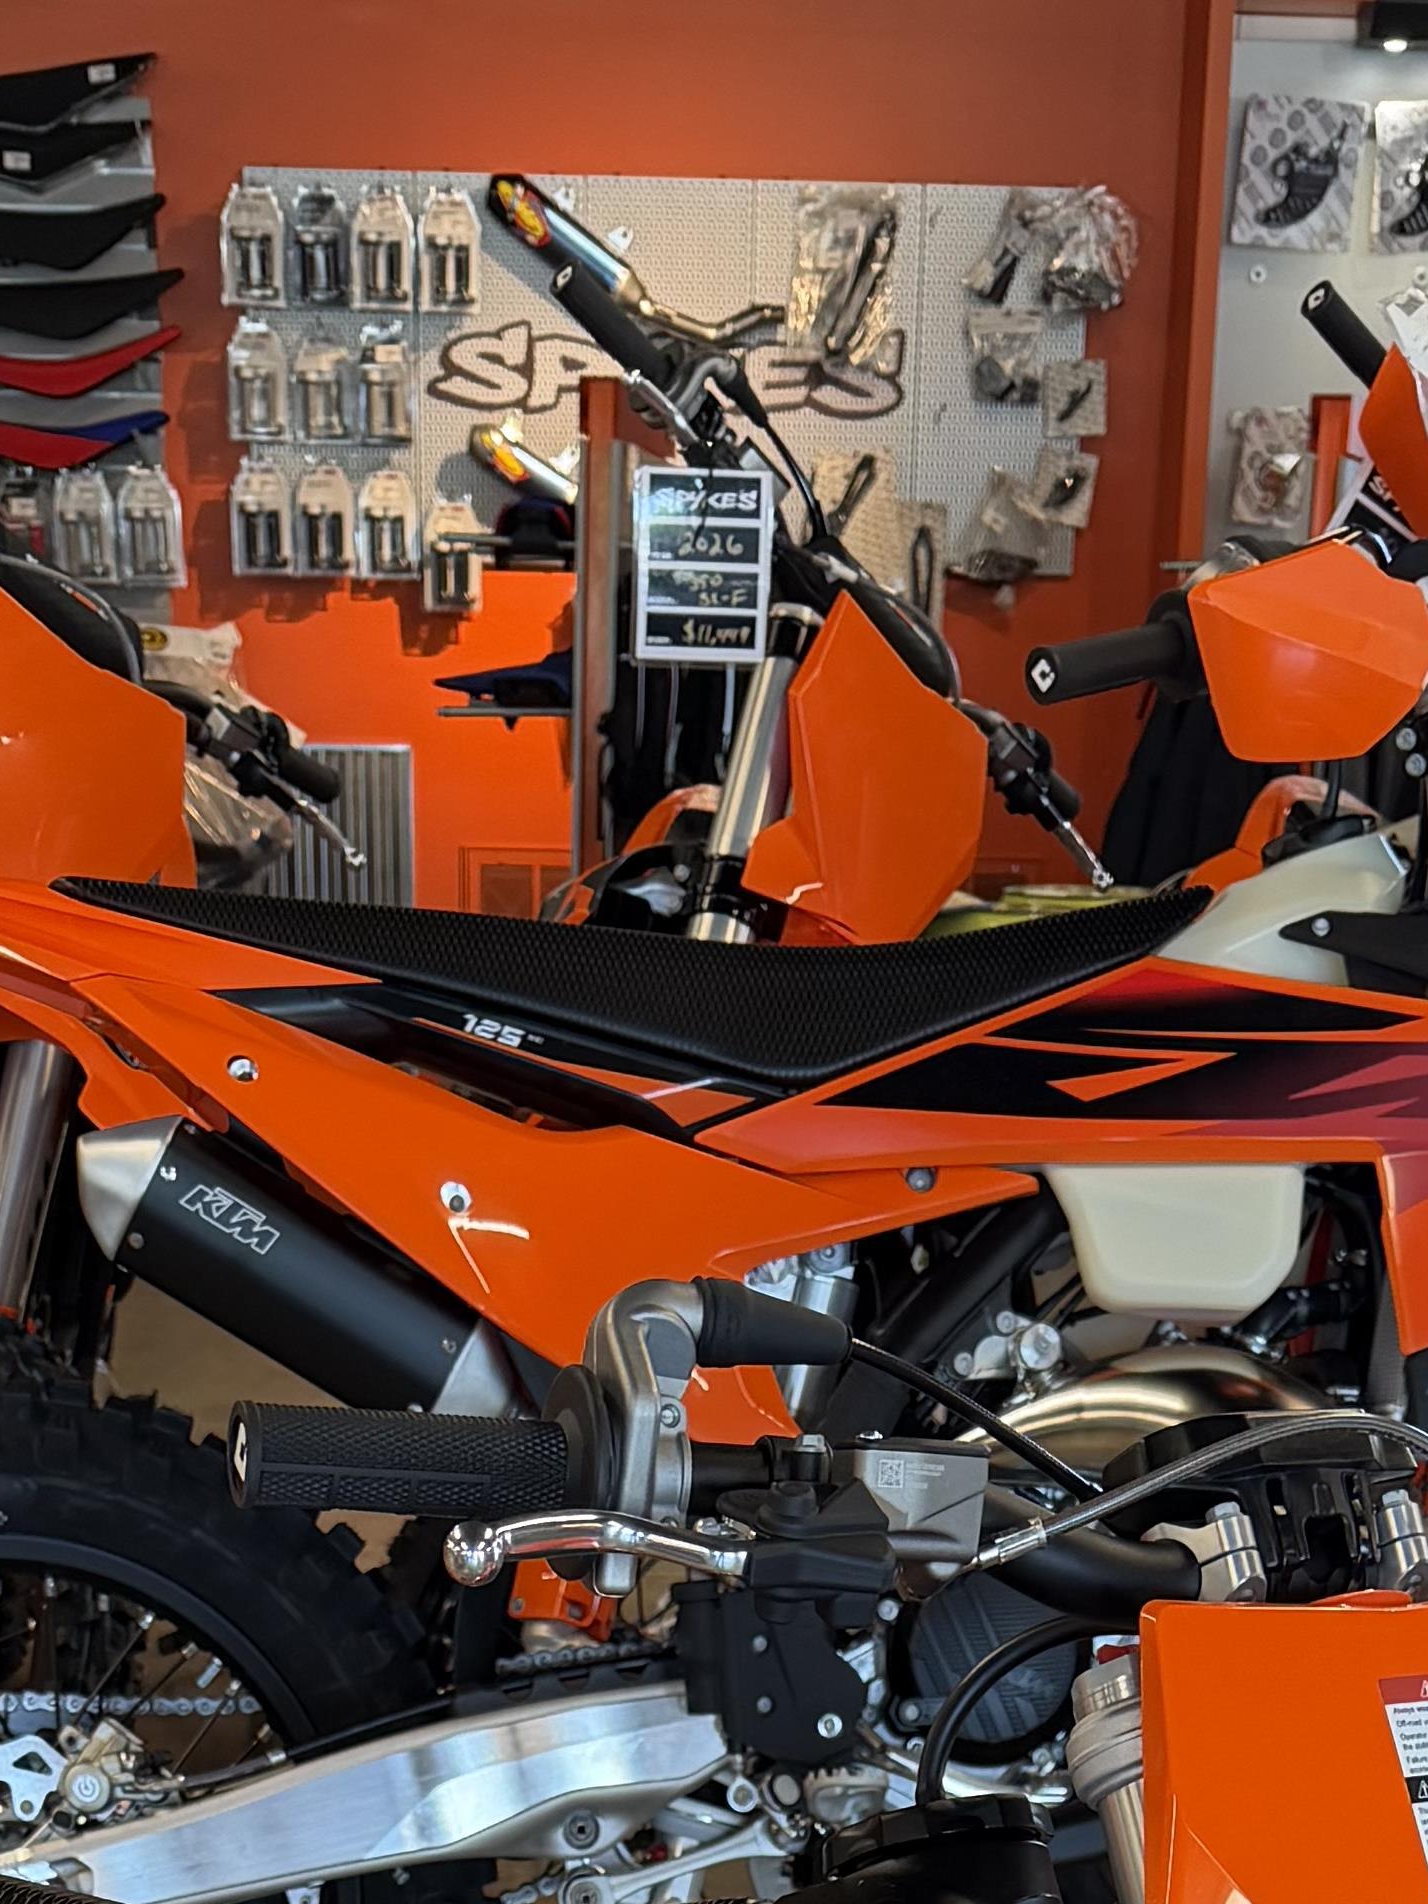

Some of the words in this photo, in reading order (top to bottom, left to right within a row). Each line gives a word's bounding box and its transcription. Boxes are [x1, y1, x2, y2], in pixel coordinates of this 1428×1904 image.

[677, 531, 745, 557] 2026
[462, 1013, 527, 1048] 125
[178, 1184, 281, 1256] KTM
